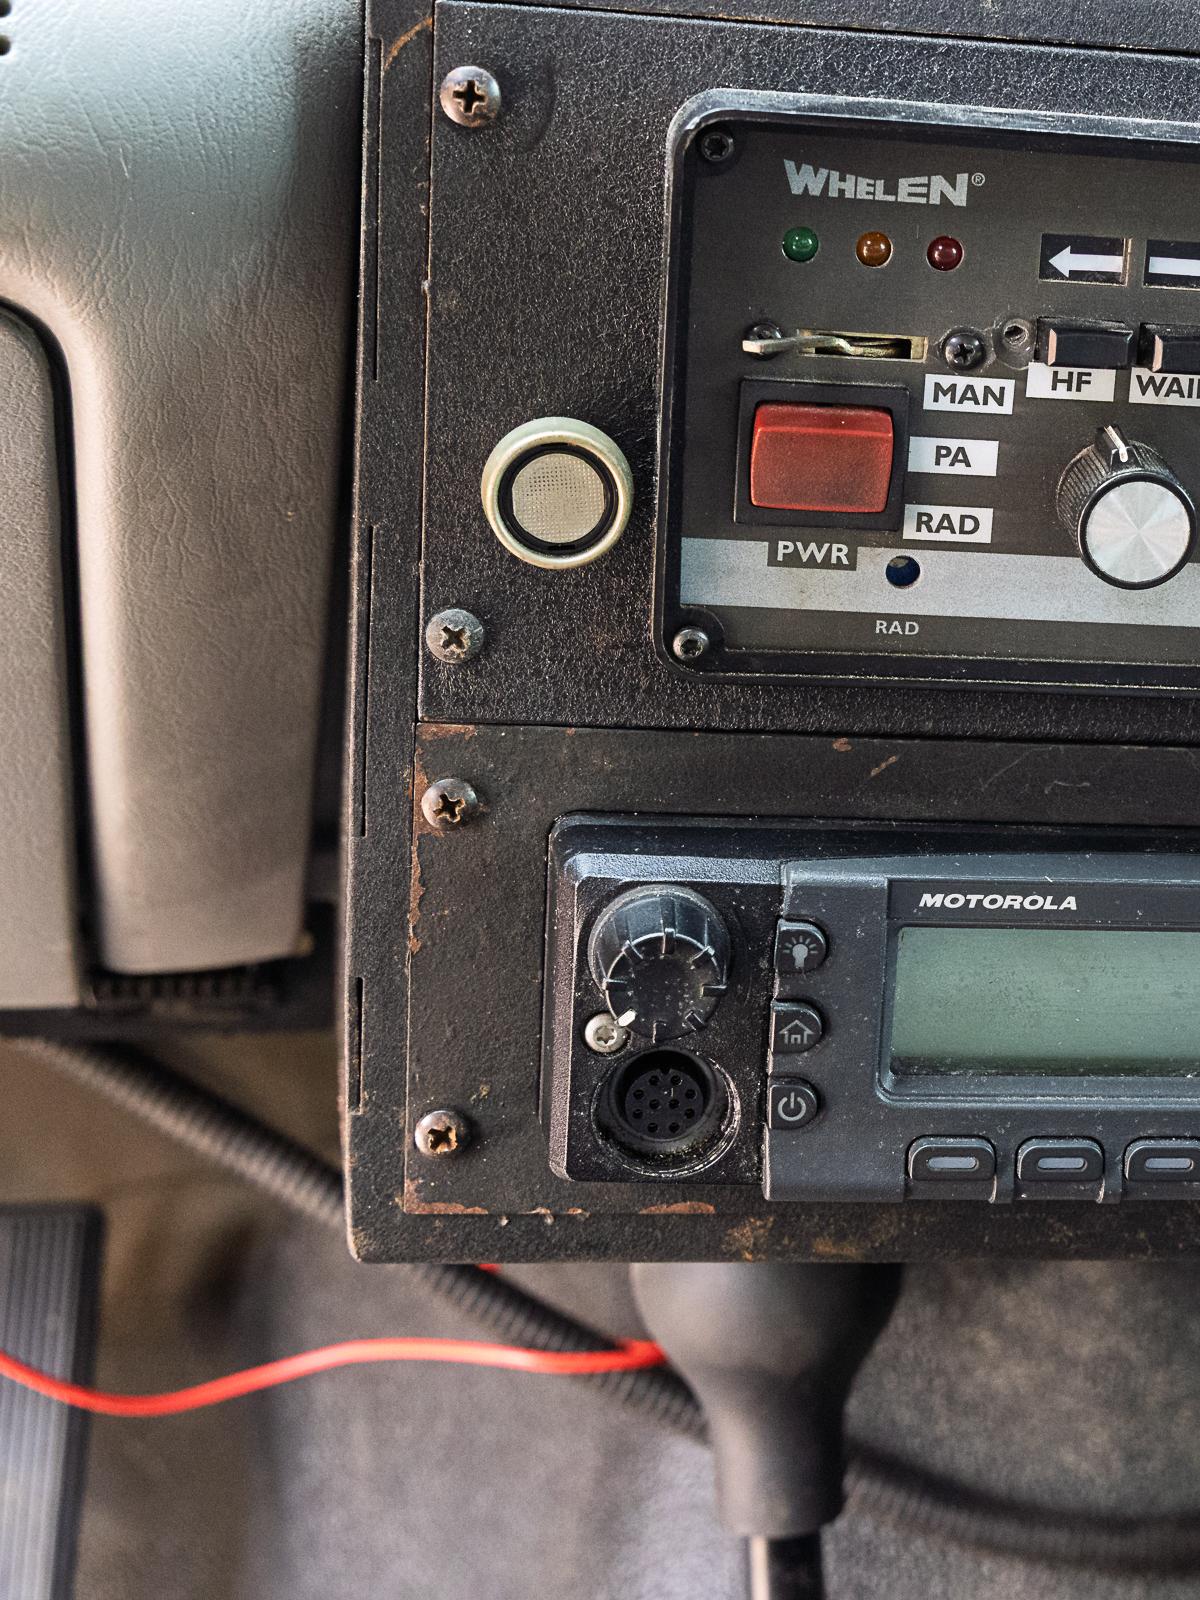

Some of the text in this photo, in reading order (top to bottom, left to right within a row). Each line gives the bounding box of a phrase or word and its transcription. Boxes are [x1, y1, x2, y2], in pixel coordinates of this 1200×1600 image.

[932, 381, 1006, 407] MAN
[1050, 371, 1093, 393] HF
[934, 444, 972, 468] PA
[915, 511, 981, 536] RAD
[776, 541, 850, 566] PWR
[875, 619, 920, 636] RAD
[918, 893, 1077, 911] MOTOROLA
